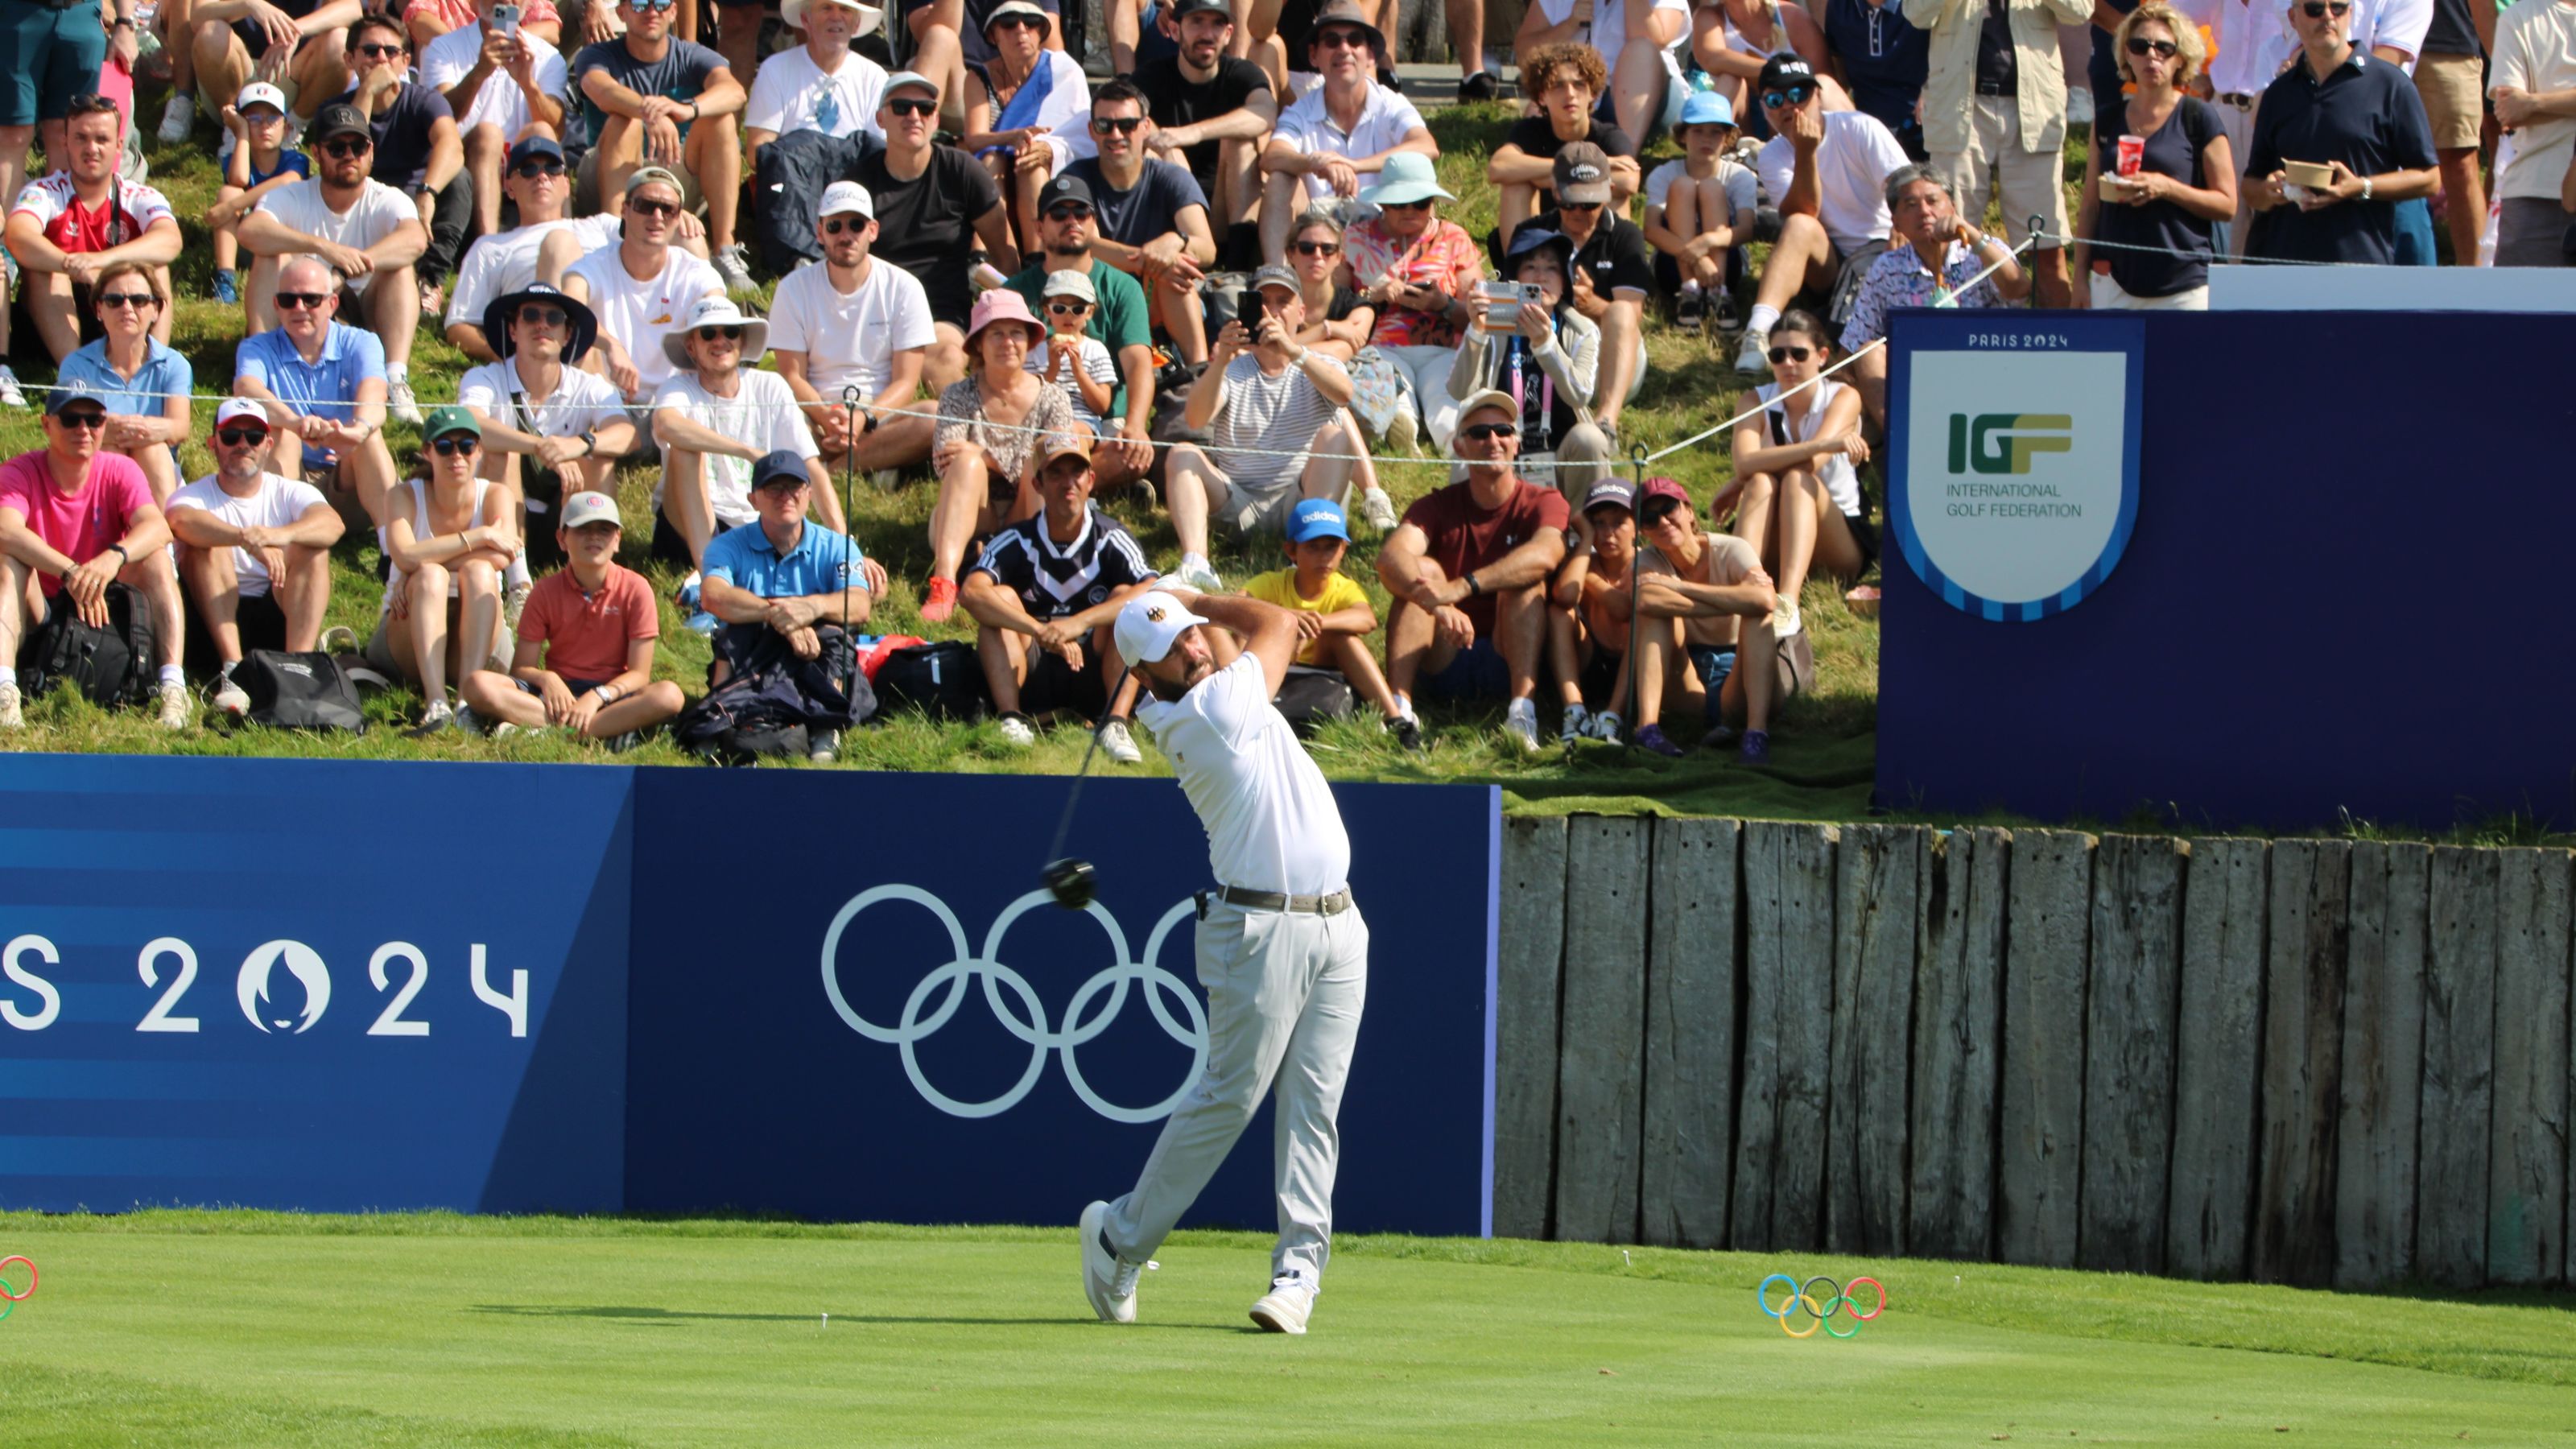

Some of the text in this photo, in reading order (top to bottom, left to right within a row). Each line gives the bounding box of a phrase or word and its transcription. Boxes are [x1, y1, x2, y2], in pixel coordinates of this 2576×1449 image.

[1968, 334, 2068, 347] PARIS 2024
[1948, 414, 2072, 474] IGF
[1591, 484, 1631, 497] adidas
[1946, 484, 2061, 497] INTERNATIONAL
[1302, 510, 1340, 524] adidas
[1946, 503, 2082, 518] GOLF FEDERATION
[135, 936, 528, 1037] 2024
